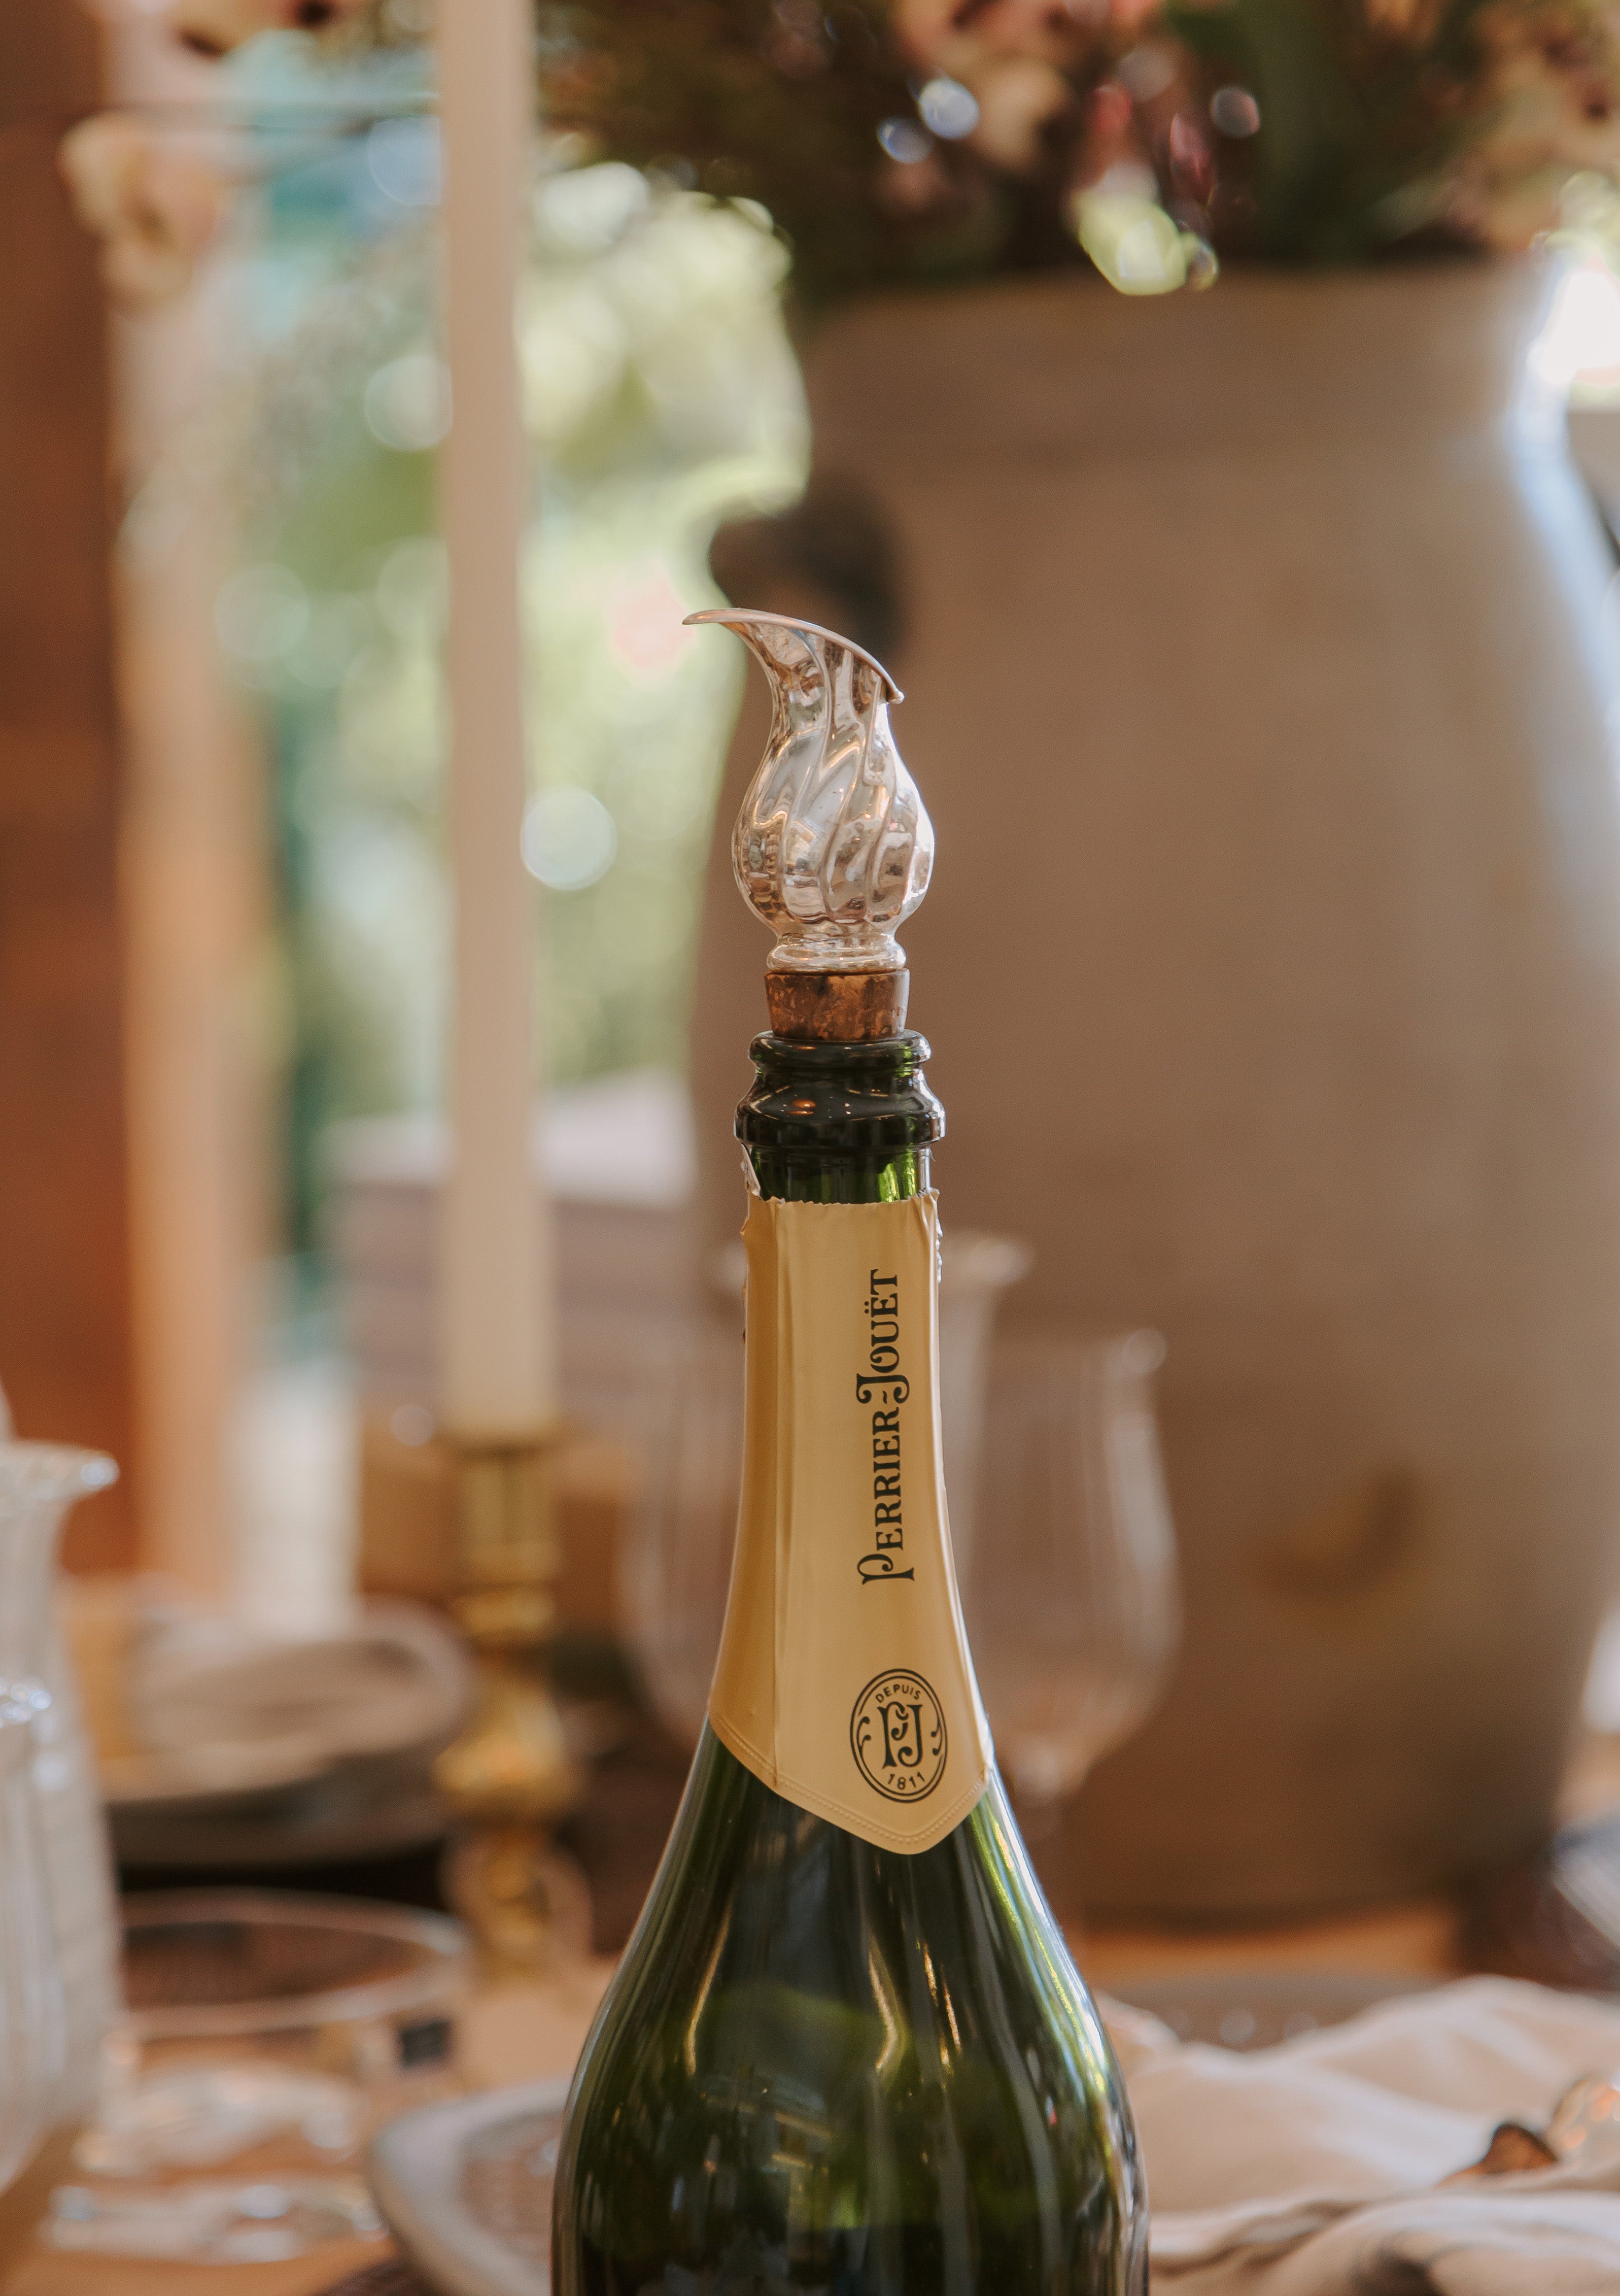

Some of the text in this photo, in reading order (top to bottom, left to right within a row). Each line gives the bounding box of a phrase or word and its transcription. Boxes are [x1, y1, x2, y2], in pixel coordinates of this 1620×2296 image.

[856, 1269, 915, 1585] PERRIER-JOUËT
[875, 1684, 921, 1703] DEPUIS
[888, 1771, 925, 1789] 1811
